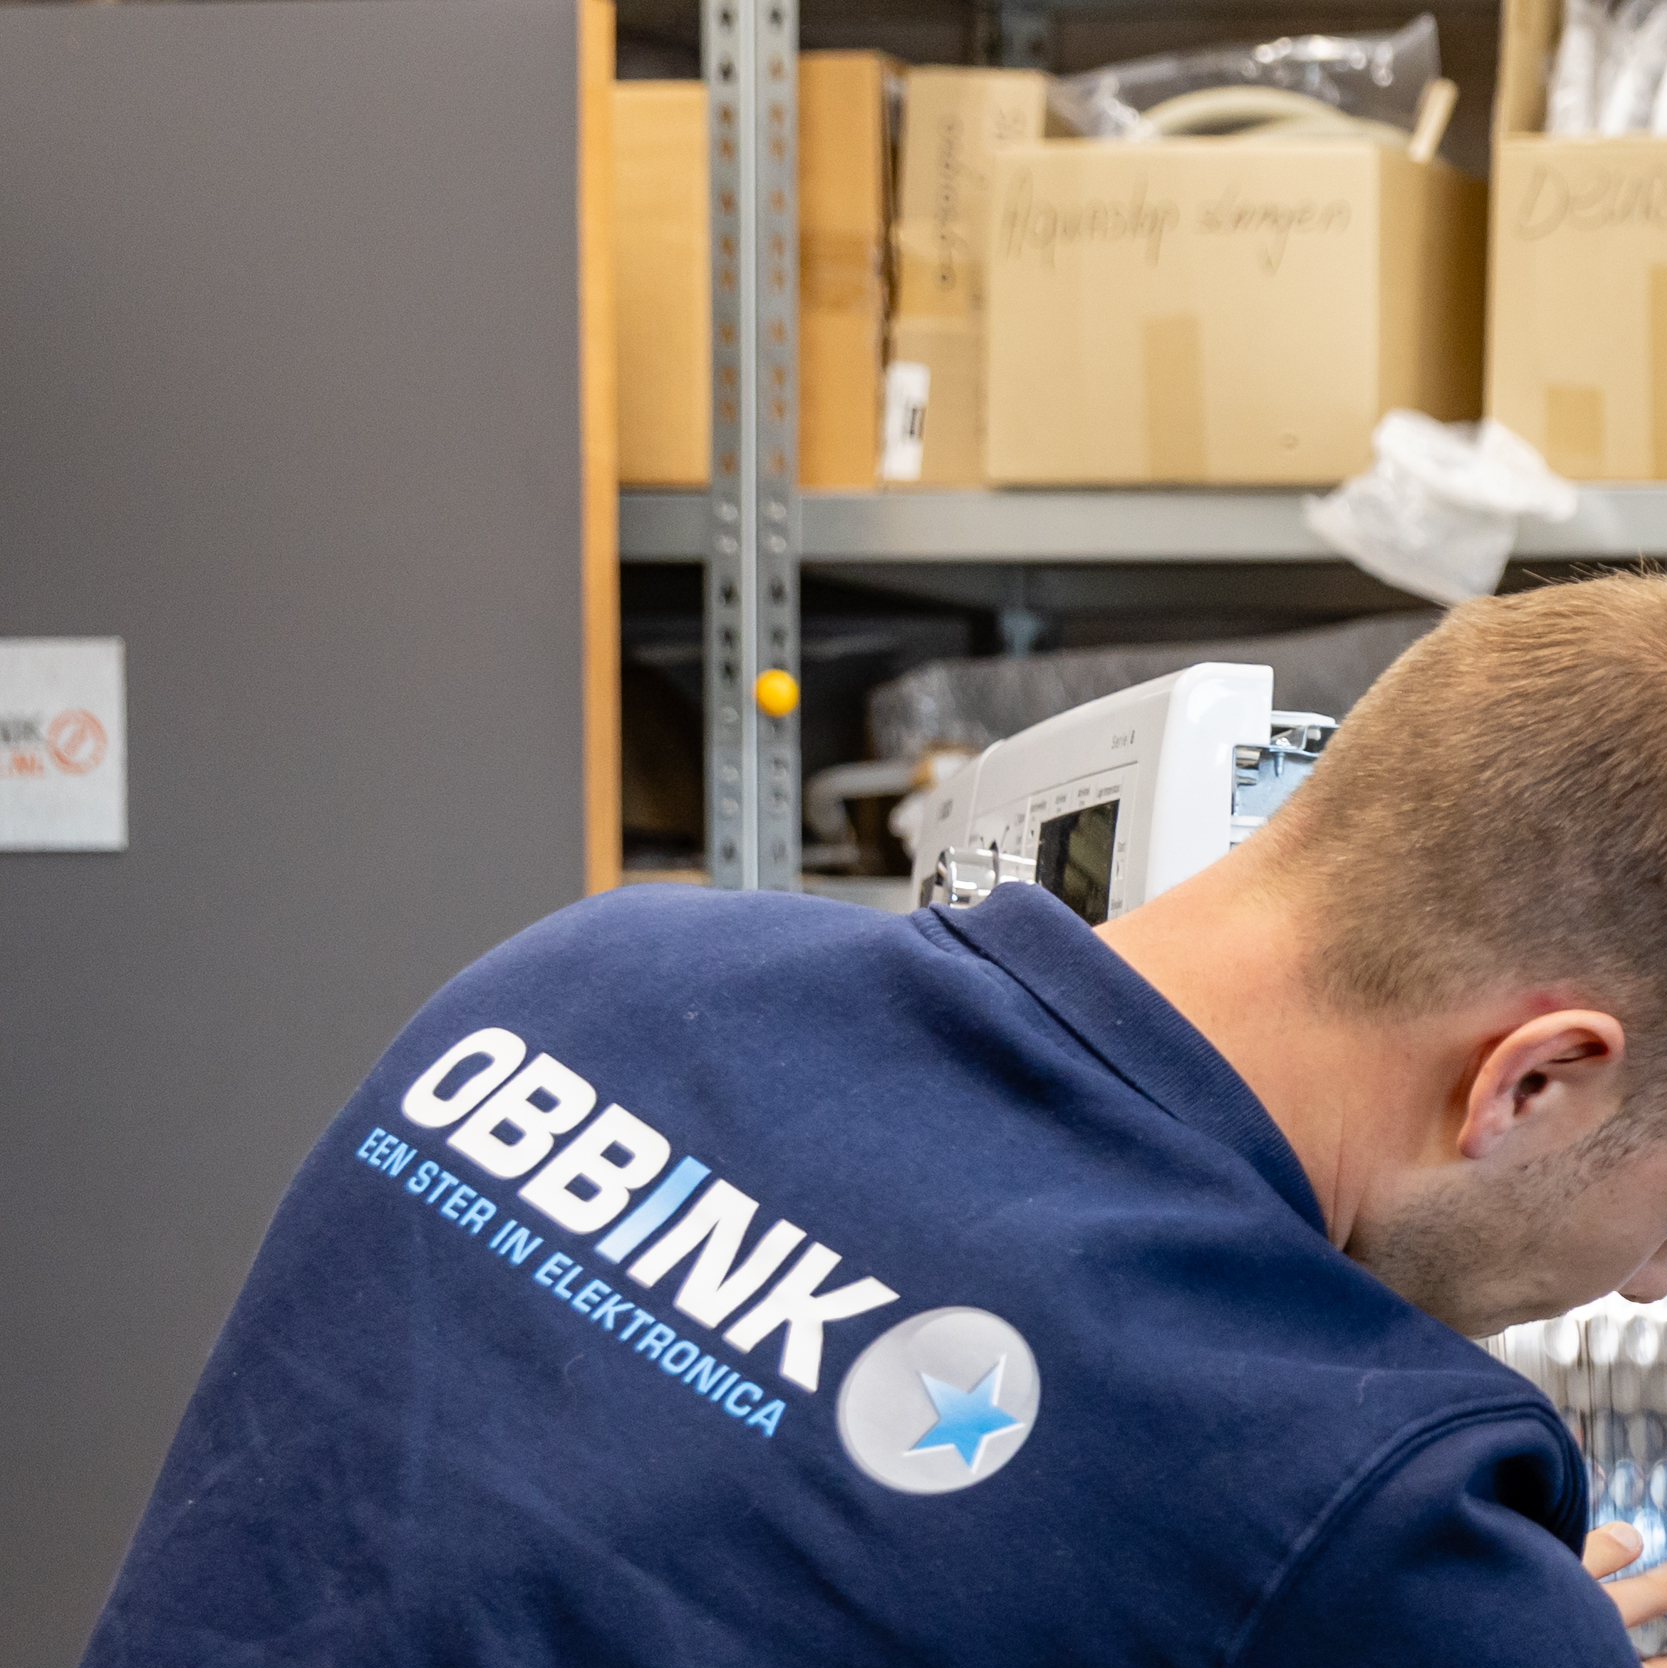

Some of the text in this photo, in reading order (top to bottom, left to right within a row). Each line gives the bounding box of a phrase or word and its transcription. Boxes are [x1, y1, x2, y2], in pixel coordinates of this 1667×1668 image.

[356, 1127, 787, 1437] EEN STER IN ELEKTRONICA
[402, 1027, 901, 1392] OBBINK
